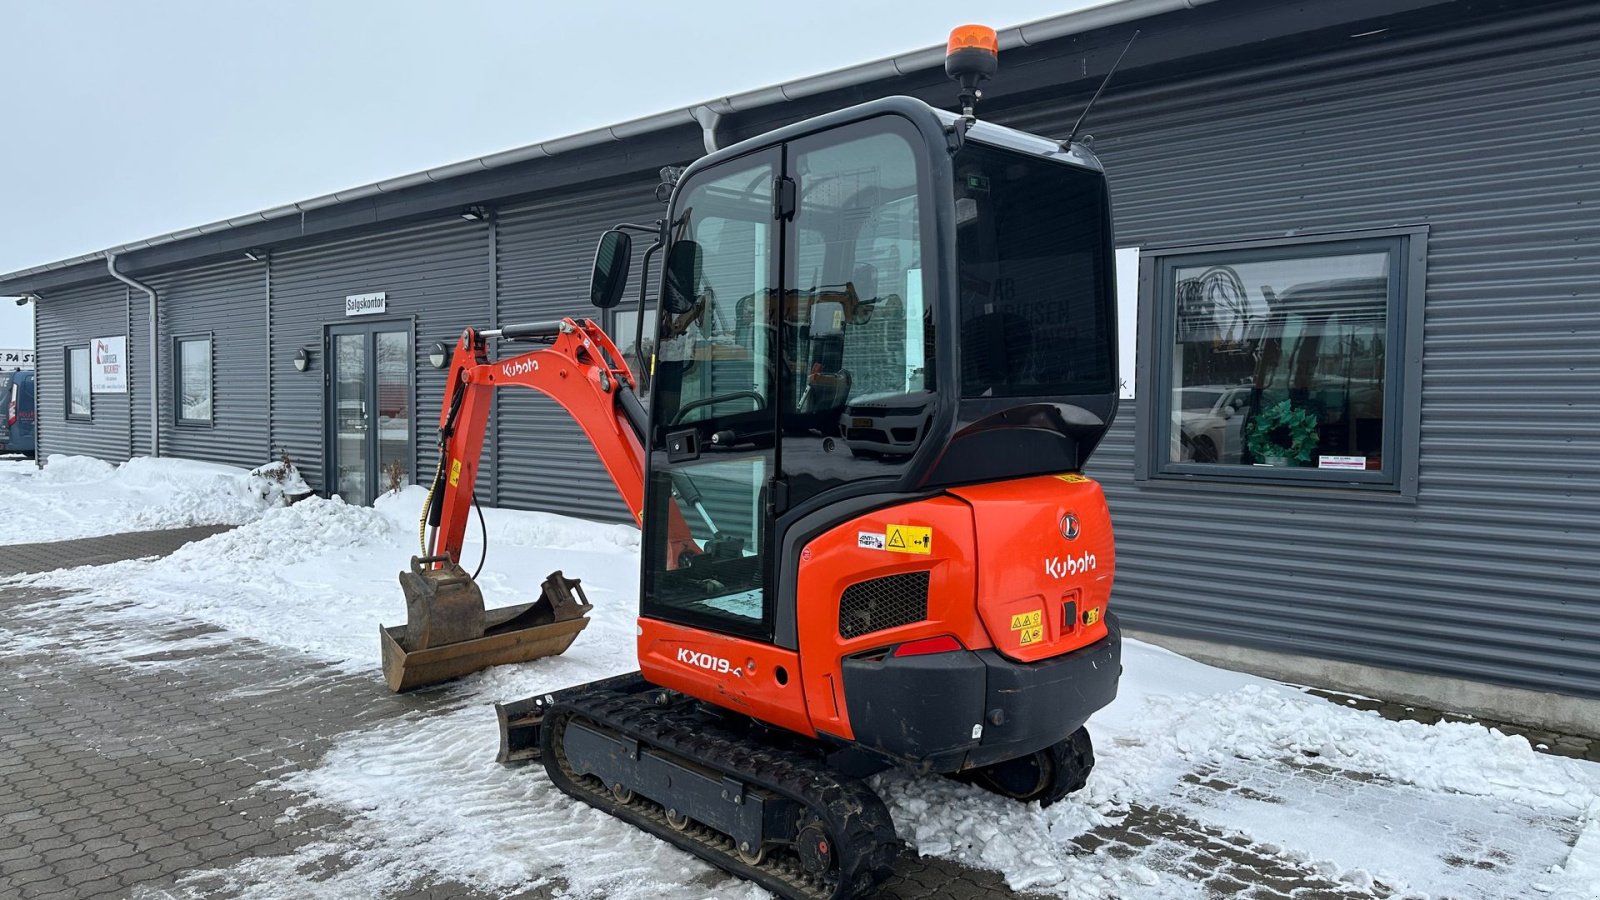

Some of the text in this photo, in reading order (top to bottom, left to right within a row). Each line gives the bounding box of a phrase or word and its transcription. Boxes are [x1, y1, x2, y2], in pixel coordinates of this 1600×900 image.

[347, 297, 384, 312] Salgskontor
[502, 358, 539, 377] Kubota
[1045, 550, 1096, 579] Kubota
